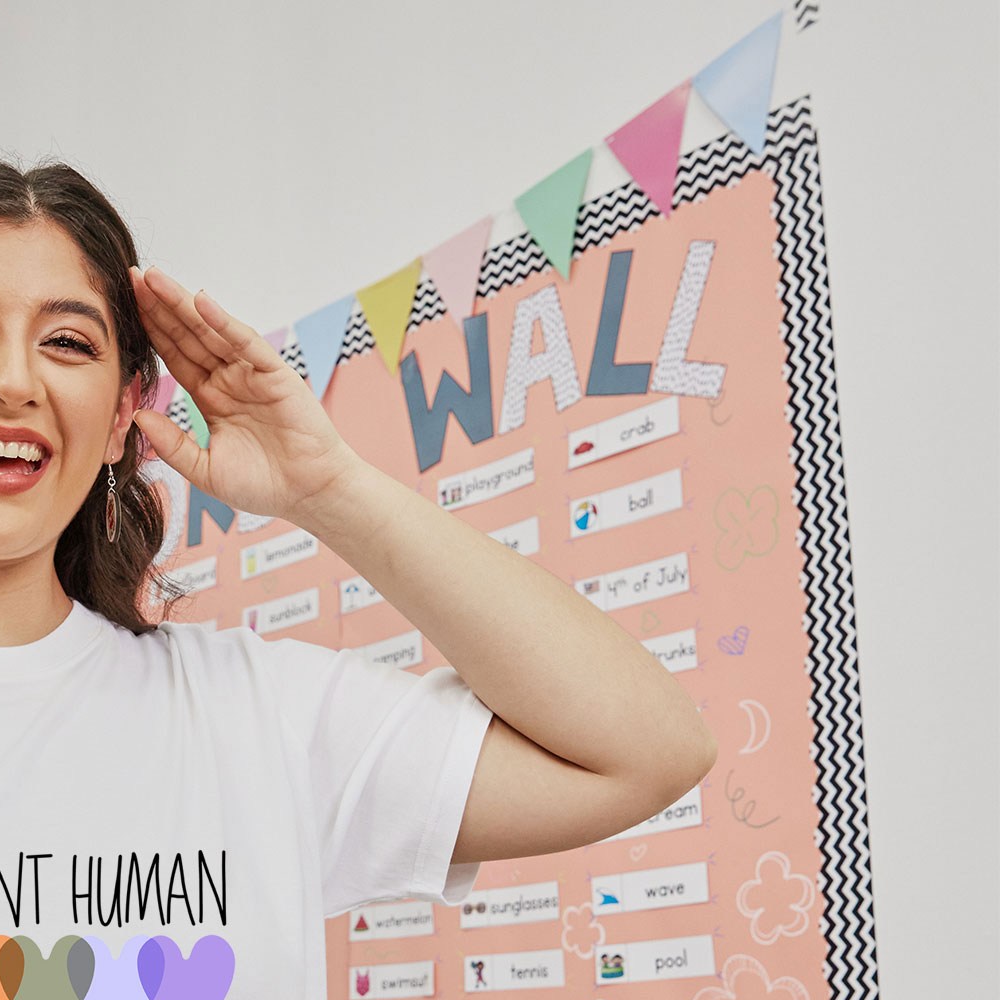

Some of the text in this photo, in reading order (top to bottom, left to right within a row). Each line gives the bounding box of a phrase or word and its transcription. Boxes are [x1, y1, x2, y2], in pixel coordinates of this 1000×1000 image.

[401, 240, 727, 473] WALL
[619, 416, 656, 442] crab
[465, 454, 534, 497] playground
[628, 488, 654, 512] ball
[265, 538, 314, 563] lemonade
[633, 571, 651, 593] of
[656, 565, 688, 587] July
[269, 601, 312, 625] sunblock
[71, 849, 228, 929] HUMAN
[644, 882, 686, 899] wave
[489, 895, 559, 917] sunglasses
[375, 911, 433, 930] watermelon
[510, 966, 549, 981] tennis
[655, 948, 689, 975] pool
